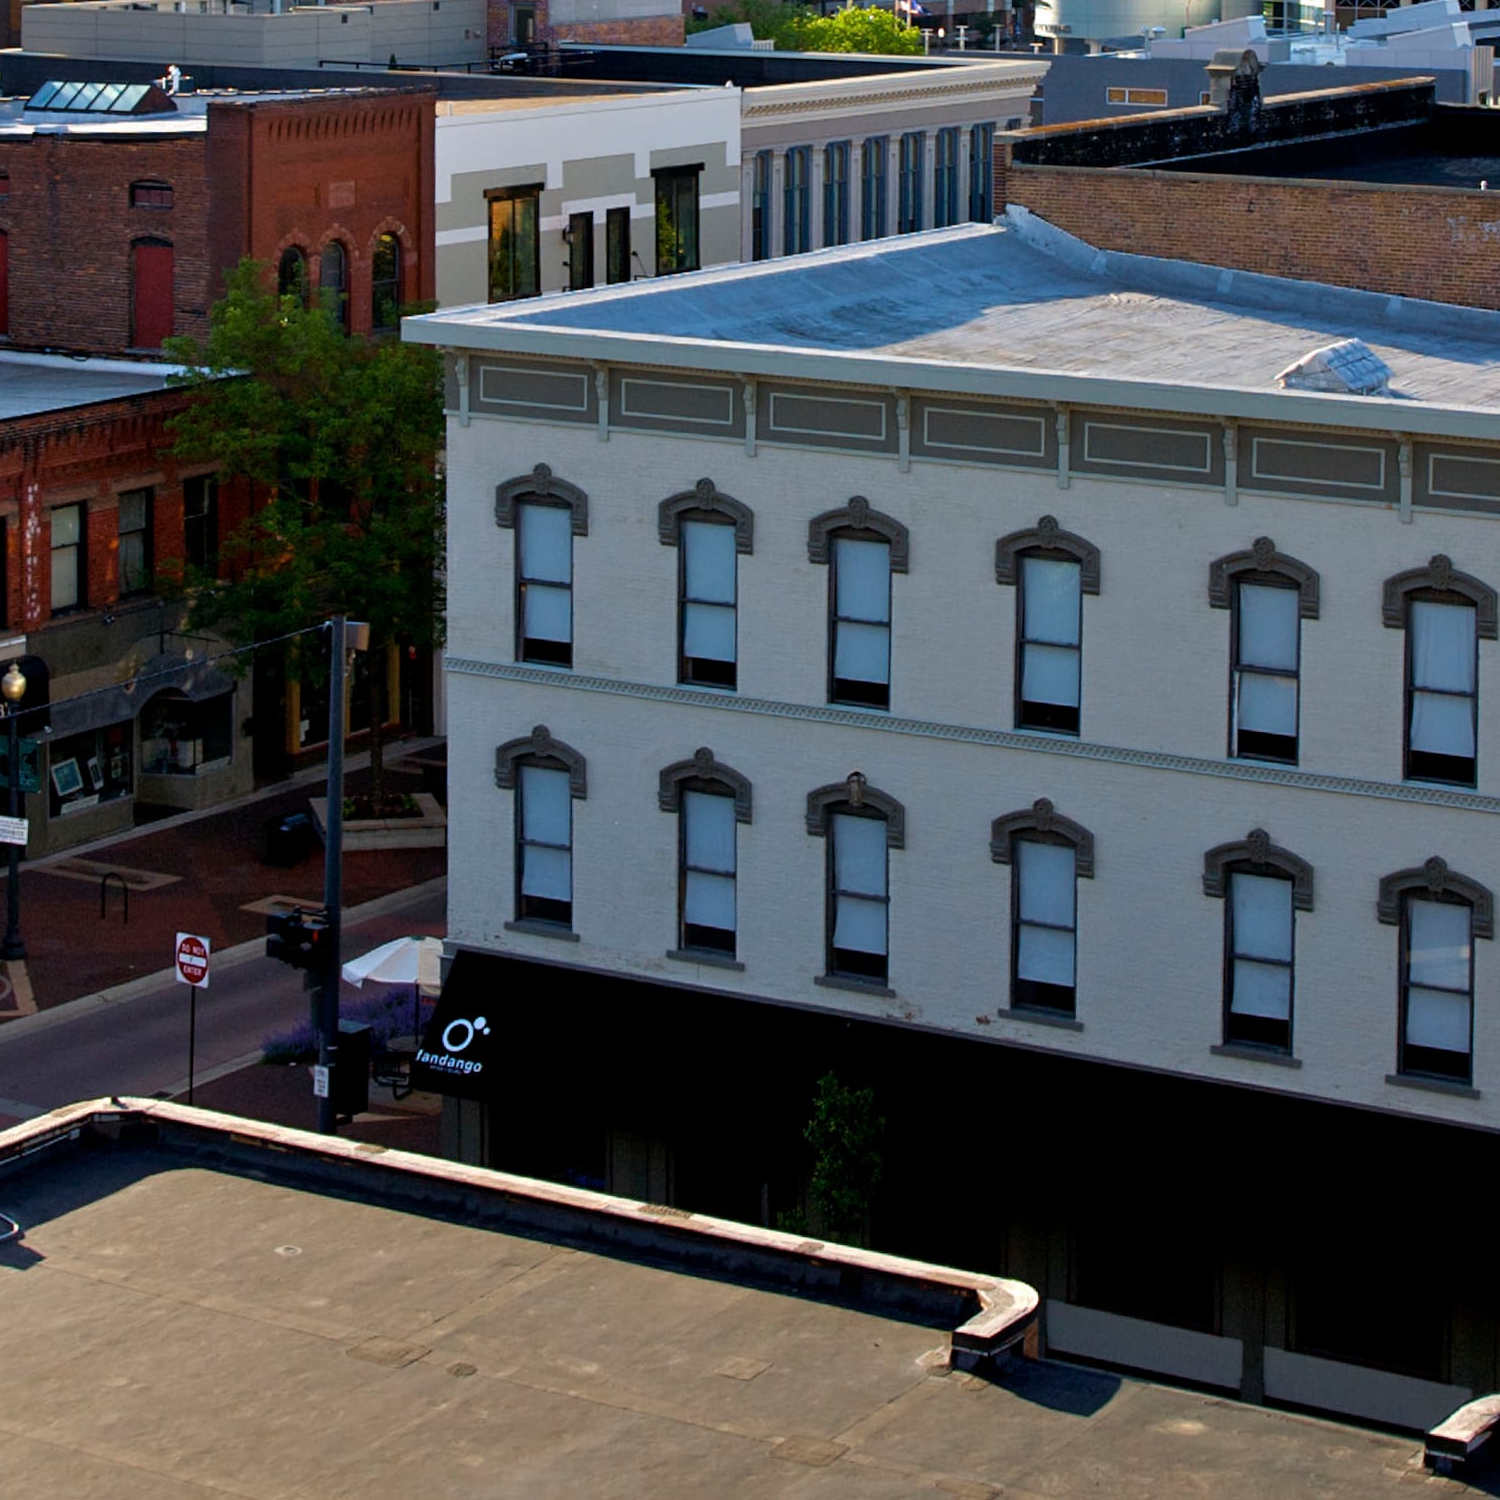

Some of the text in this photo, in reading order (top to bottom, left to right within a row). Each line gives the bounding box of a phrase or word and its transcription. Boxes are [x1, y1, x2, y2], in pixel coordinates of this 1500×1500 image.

[182, 943, 205, 957] DO NOT
[183, 965, 202, 976] ENTER
[416, 1049, 482, 1074] fandango
